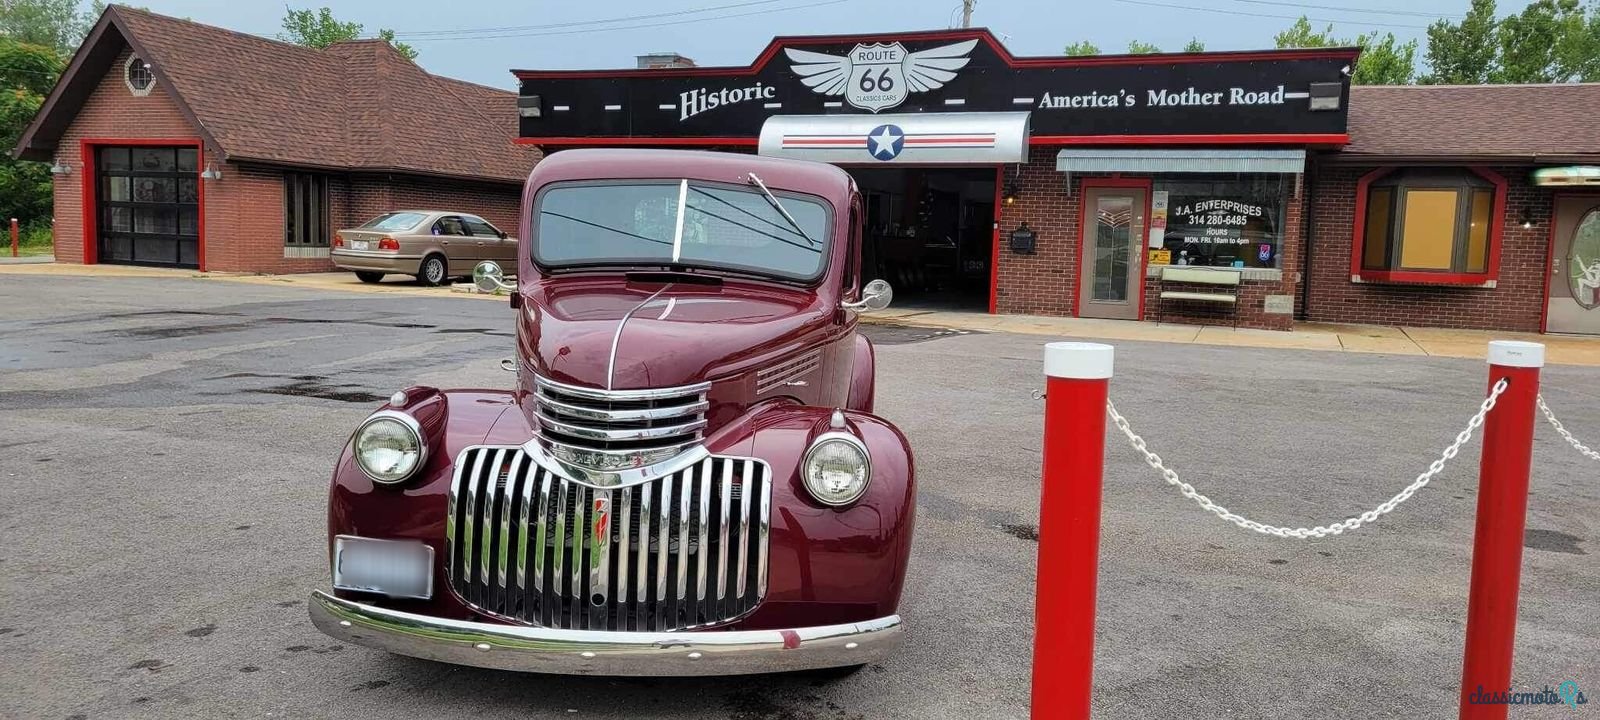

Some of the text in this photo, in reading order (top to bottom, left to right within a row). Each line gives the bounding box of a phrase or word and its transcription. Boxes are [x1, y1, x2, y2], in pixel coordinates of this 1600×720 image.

[858, 50, 896, 61] ROUTE
[859, 67, 894, 92] 66
[679, 82, 776, 121] Historic
[1038, 85, 1285, 109] America's Mother Road
[1175, 205, 1193, 216] J.A.
[1195, 200, 1262, 217] ENTERPRISES
[1188, 215, 1247, 225] 314 280-6485
[1206, 228, 1228, 236] HOURS
